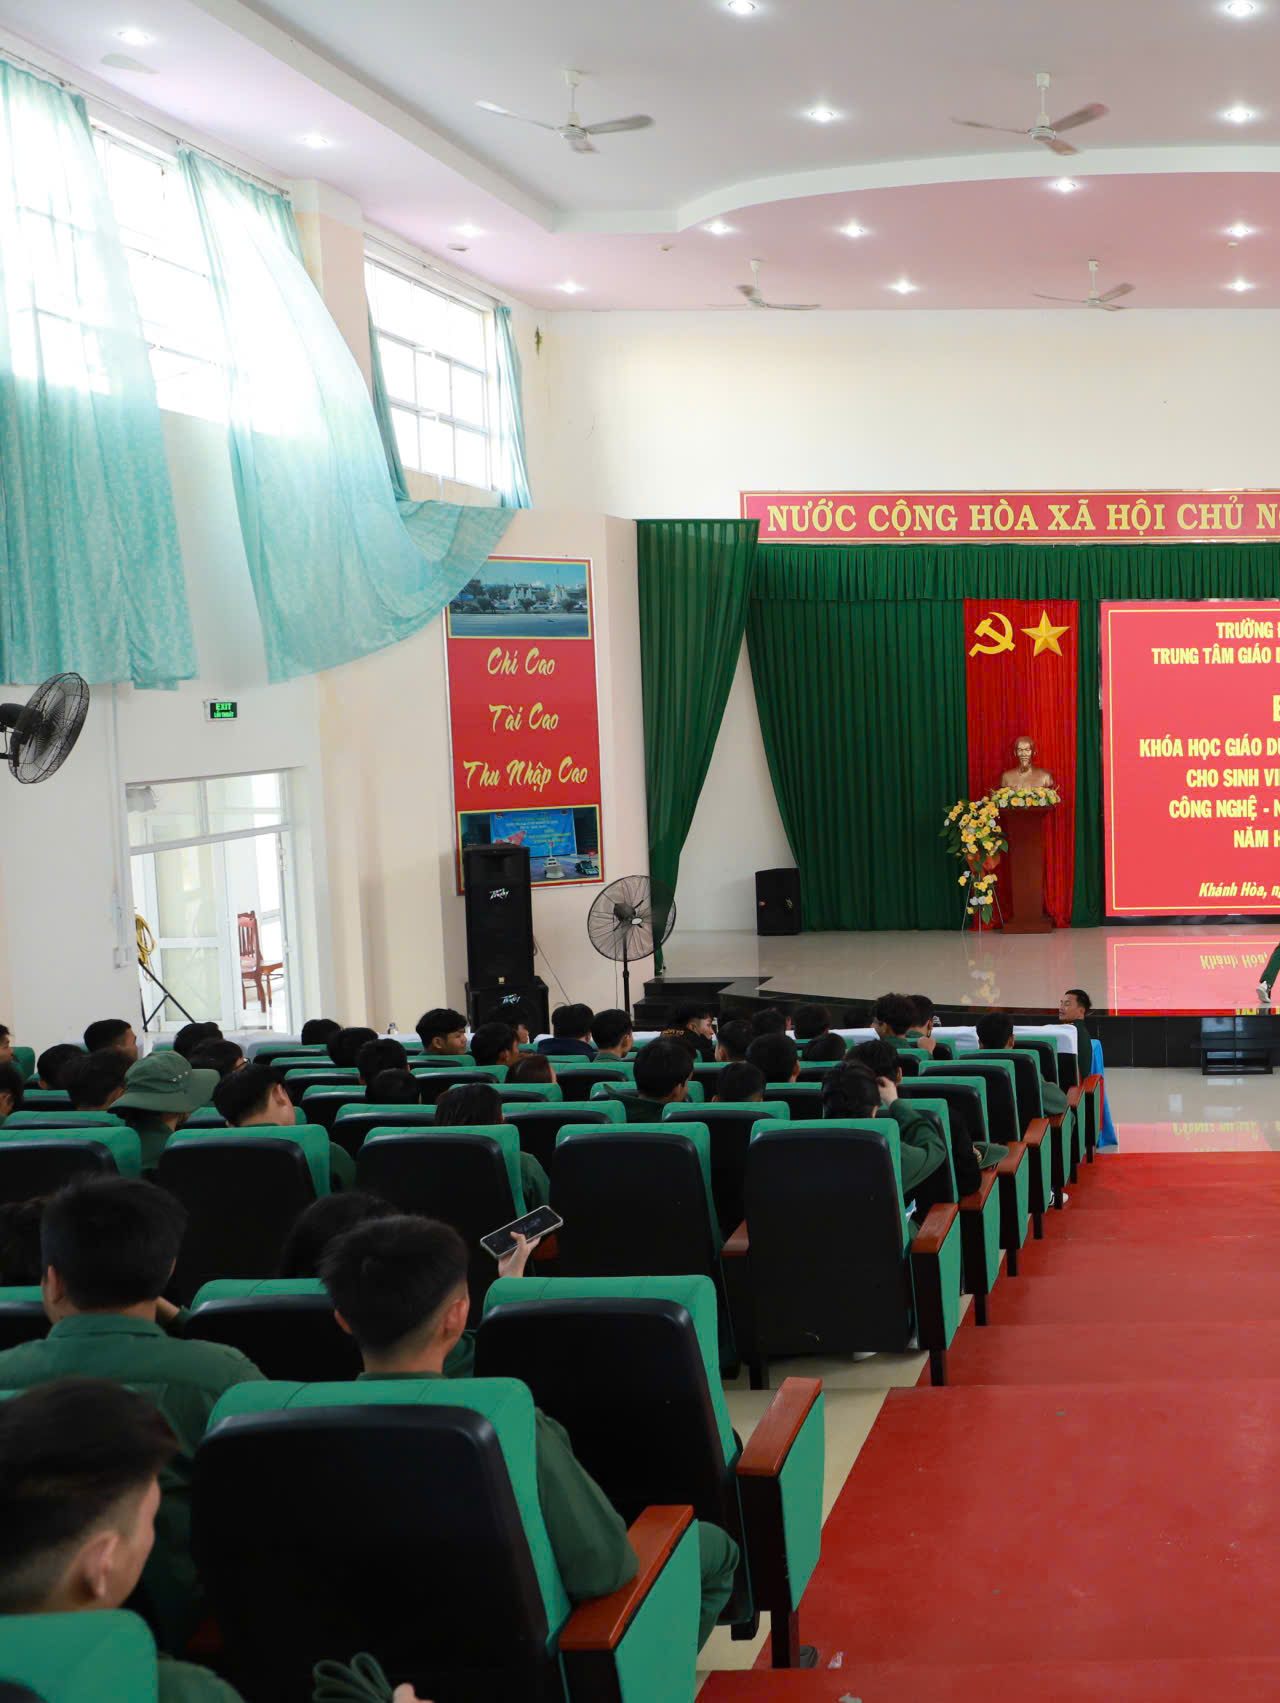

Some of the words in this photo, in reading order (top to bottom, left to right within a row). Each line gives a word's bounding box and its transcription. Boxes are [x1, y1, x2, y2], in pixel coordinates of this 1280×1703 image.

[767, 498, 856, 532] NƯỚC
[868, 499, 958, 537] CỘNG
[968, 498, 1039, 531] HÒA
[1048, 499, 1096, 530] XÃ
[1106, 499, 1166, 536] HỘI
[1176, 495, 1244, 530] CHỦ
[1216, 618, 1273, 638] TRƯỜNG
[525, 648, 555, 675] Cao
[1152, 648, 1199, 664] TRUNG
[1203, 643, 1234, 664] TÂM
[1238, 643, 1272, 664] GIÁO
[489, 704, 523, 731] Tài
[529, 702, 558, 730] Cao
[1140, 734, 1183, 757] KHÓA
[1188, 738, 1221, 760] HỌC
[1225, 734, 1262, 756] GIÁO
[463, 761, 499, 788] Thu
[506, 760, 552, 792] Nhập
[559, 756, 587, 783] Cao
[1187, 769, 1218, 787] CHO
[1223, 769, 1259, 787] SINH
[1169, 796, 1212, 818] CÔNG
[1216, 795, 1257, 820] NGHỆ
[1234, 826, 1269, 848] NĂM
[1199, 882, 1238, 896] Khánh
[1240, 882, 1267, 898] Hòa,
